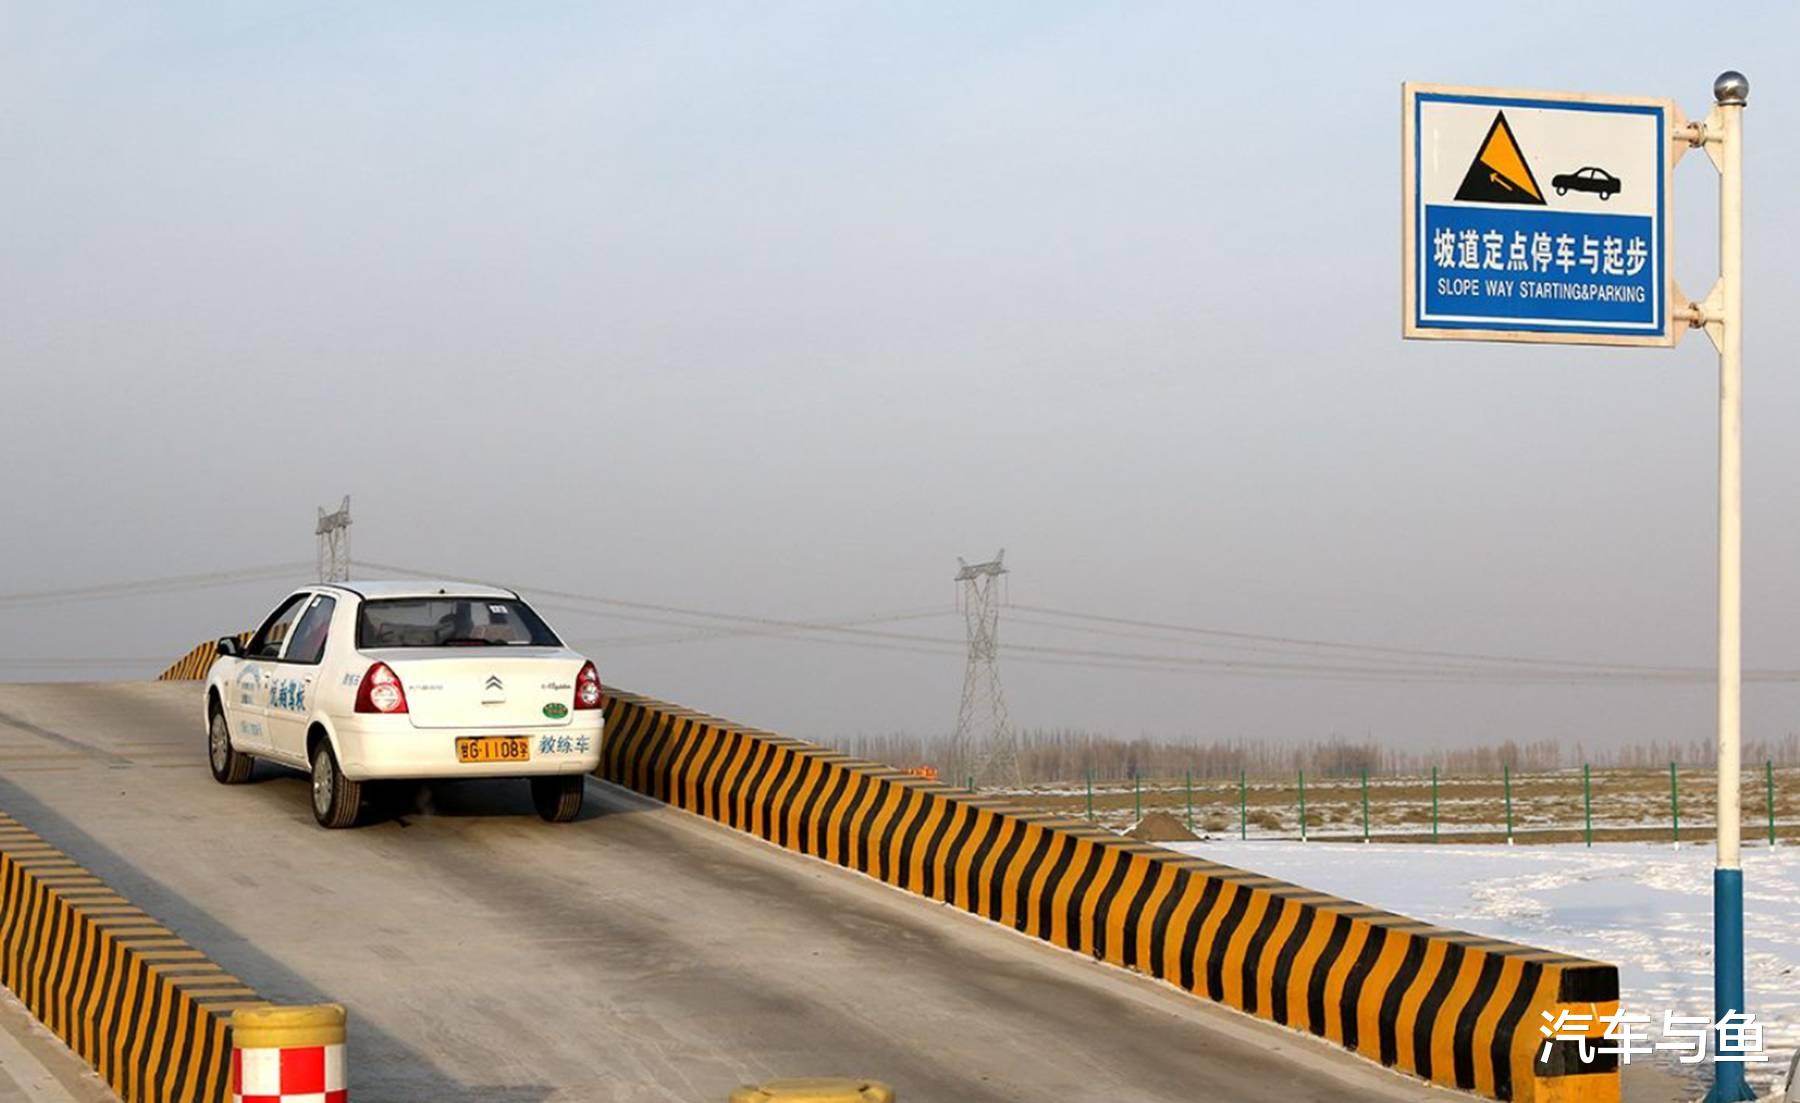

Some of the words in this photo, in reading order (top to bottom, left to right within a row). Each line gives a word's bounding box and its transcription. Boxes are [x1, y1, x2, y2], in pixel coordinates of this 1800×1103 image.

[1433, 227, 1648, 276] 坡道定点停车与起步
[1437, 278, 1480, 296] SLOPE
[1485, 279, 1514, 298] WAY
[1519, 280, 1645, 303] STARTING&PARKING
[539, 734, 591, 754] 教练车
